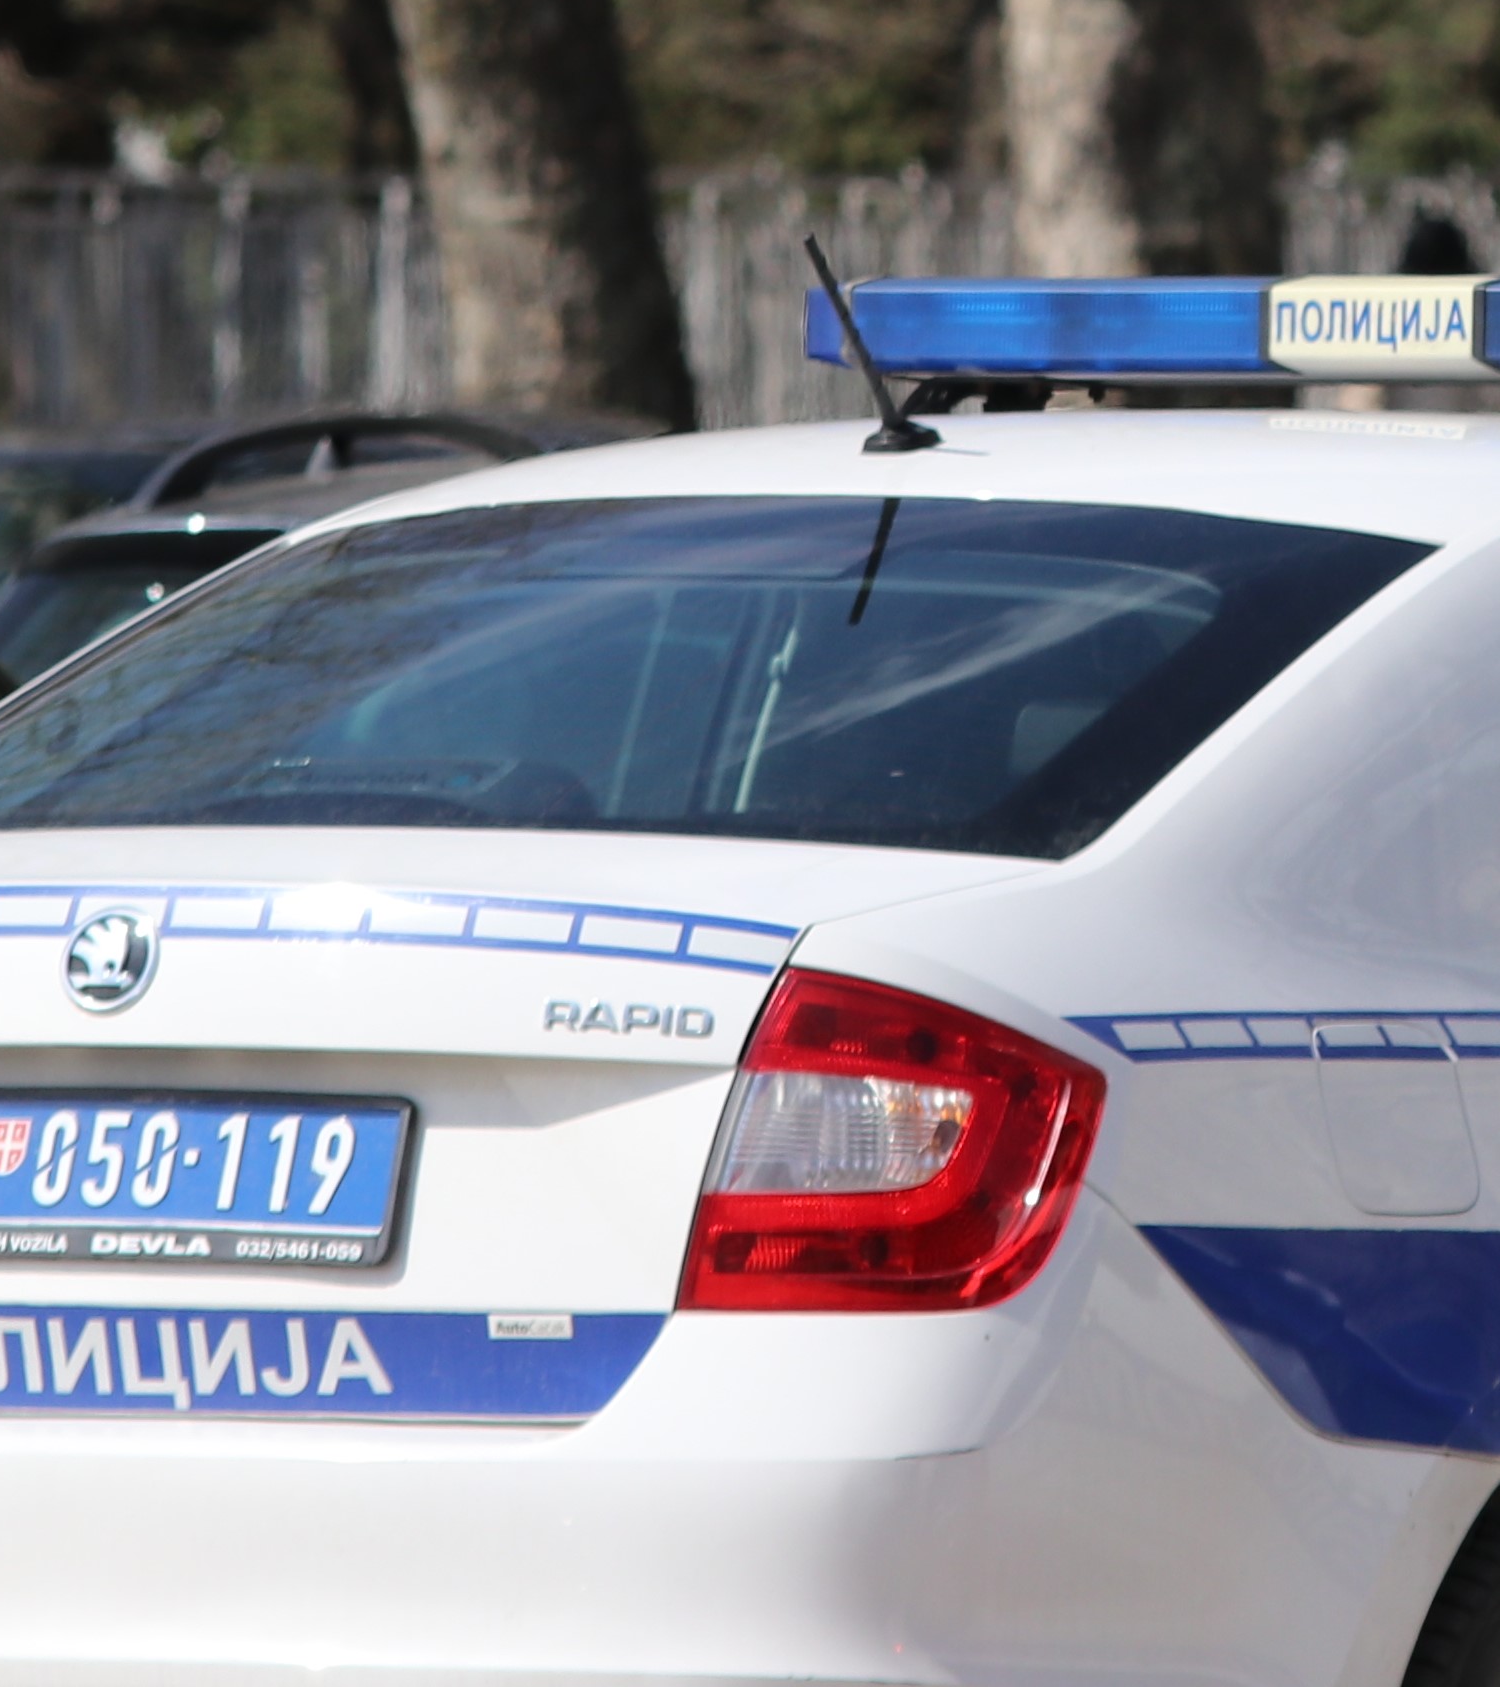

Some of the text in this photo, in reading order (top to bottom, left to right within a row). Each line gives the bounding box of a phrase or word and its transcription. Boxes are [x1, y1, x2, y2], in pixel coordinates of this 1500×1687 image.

[1275, 299, 1467, 353] ПОЛИЦИЈА
[543, 999, 716, 1039] RAPID
[9, 1232, 69, 1254] VOZILA
[90, 1232, 212, 1257] DEVLA
